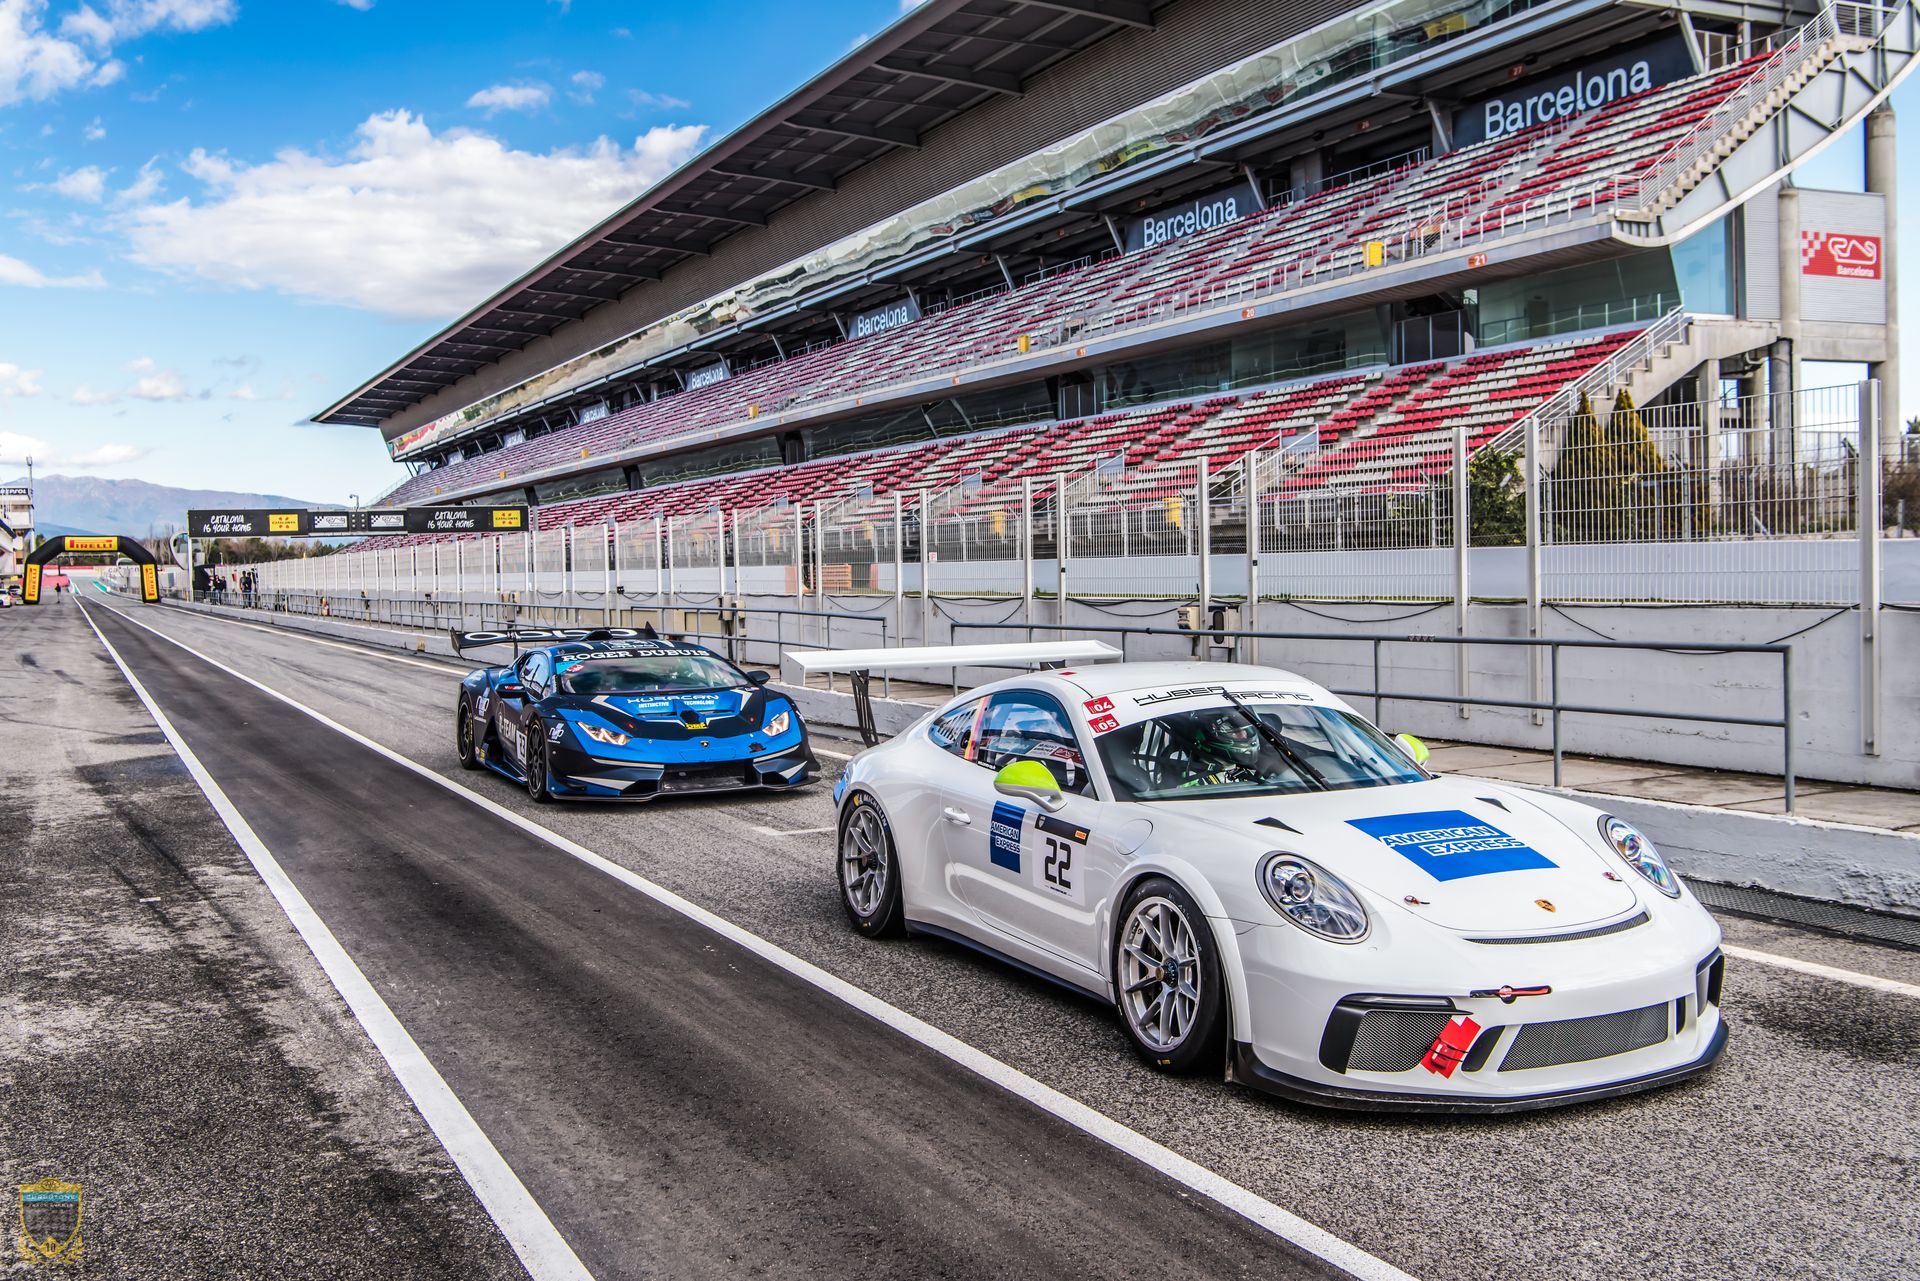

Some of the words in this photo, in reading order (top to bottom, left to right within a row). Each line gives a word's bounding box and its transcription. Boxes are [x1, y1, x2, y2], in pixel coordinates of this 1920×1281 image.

[1485, 61, 1652, 139] Barcelona
[1143, 197, 1237, 247] Barcelona
[1475, 254, 1486, 266] 21
[856, 305, 908, 337] Barcelona
[691, 367, 724, 389] Barcelona
[210, 514, 245, 524] CATALONIA
[434, 511, 468, 520] CATALONIA
[437, 519, 454, 528] YOUR
[455, 519, 475, 528] HOME
[212, 524, 231, 533] YOUR
[231, 523, 252, 532] HOME
[70, 539, 113, 549] PIRELLI
[28, 567, 37, 597] PIRELLI
[145, 567, 155, 597] PIRELLI
[561, 650, 633, 662] ROGER
[637, 649, 710, 657] DUBUIS
[1133, 686, 1226, 705] HUBER
[1222, 691, 1314, 702] RACING
[1094, 701, 1113, 713] 04
[1099, 718, 1119, 731] 05
[991, 821, 1020, 840] AMERICAN
[1381, 826, 1499, 846] AMERICAN
[995, 836, 1021, 853] EXPRESS
[1420, 838, 1528, 856] EXPRESS
[1044, 837, 1071, 889] 22
